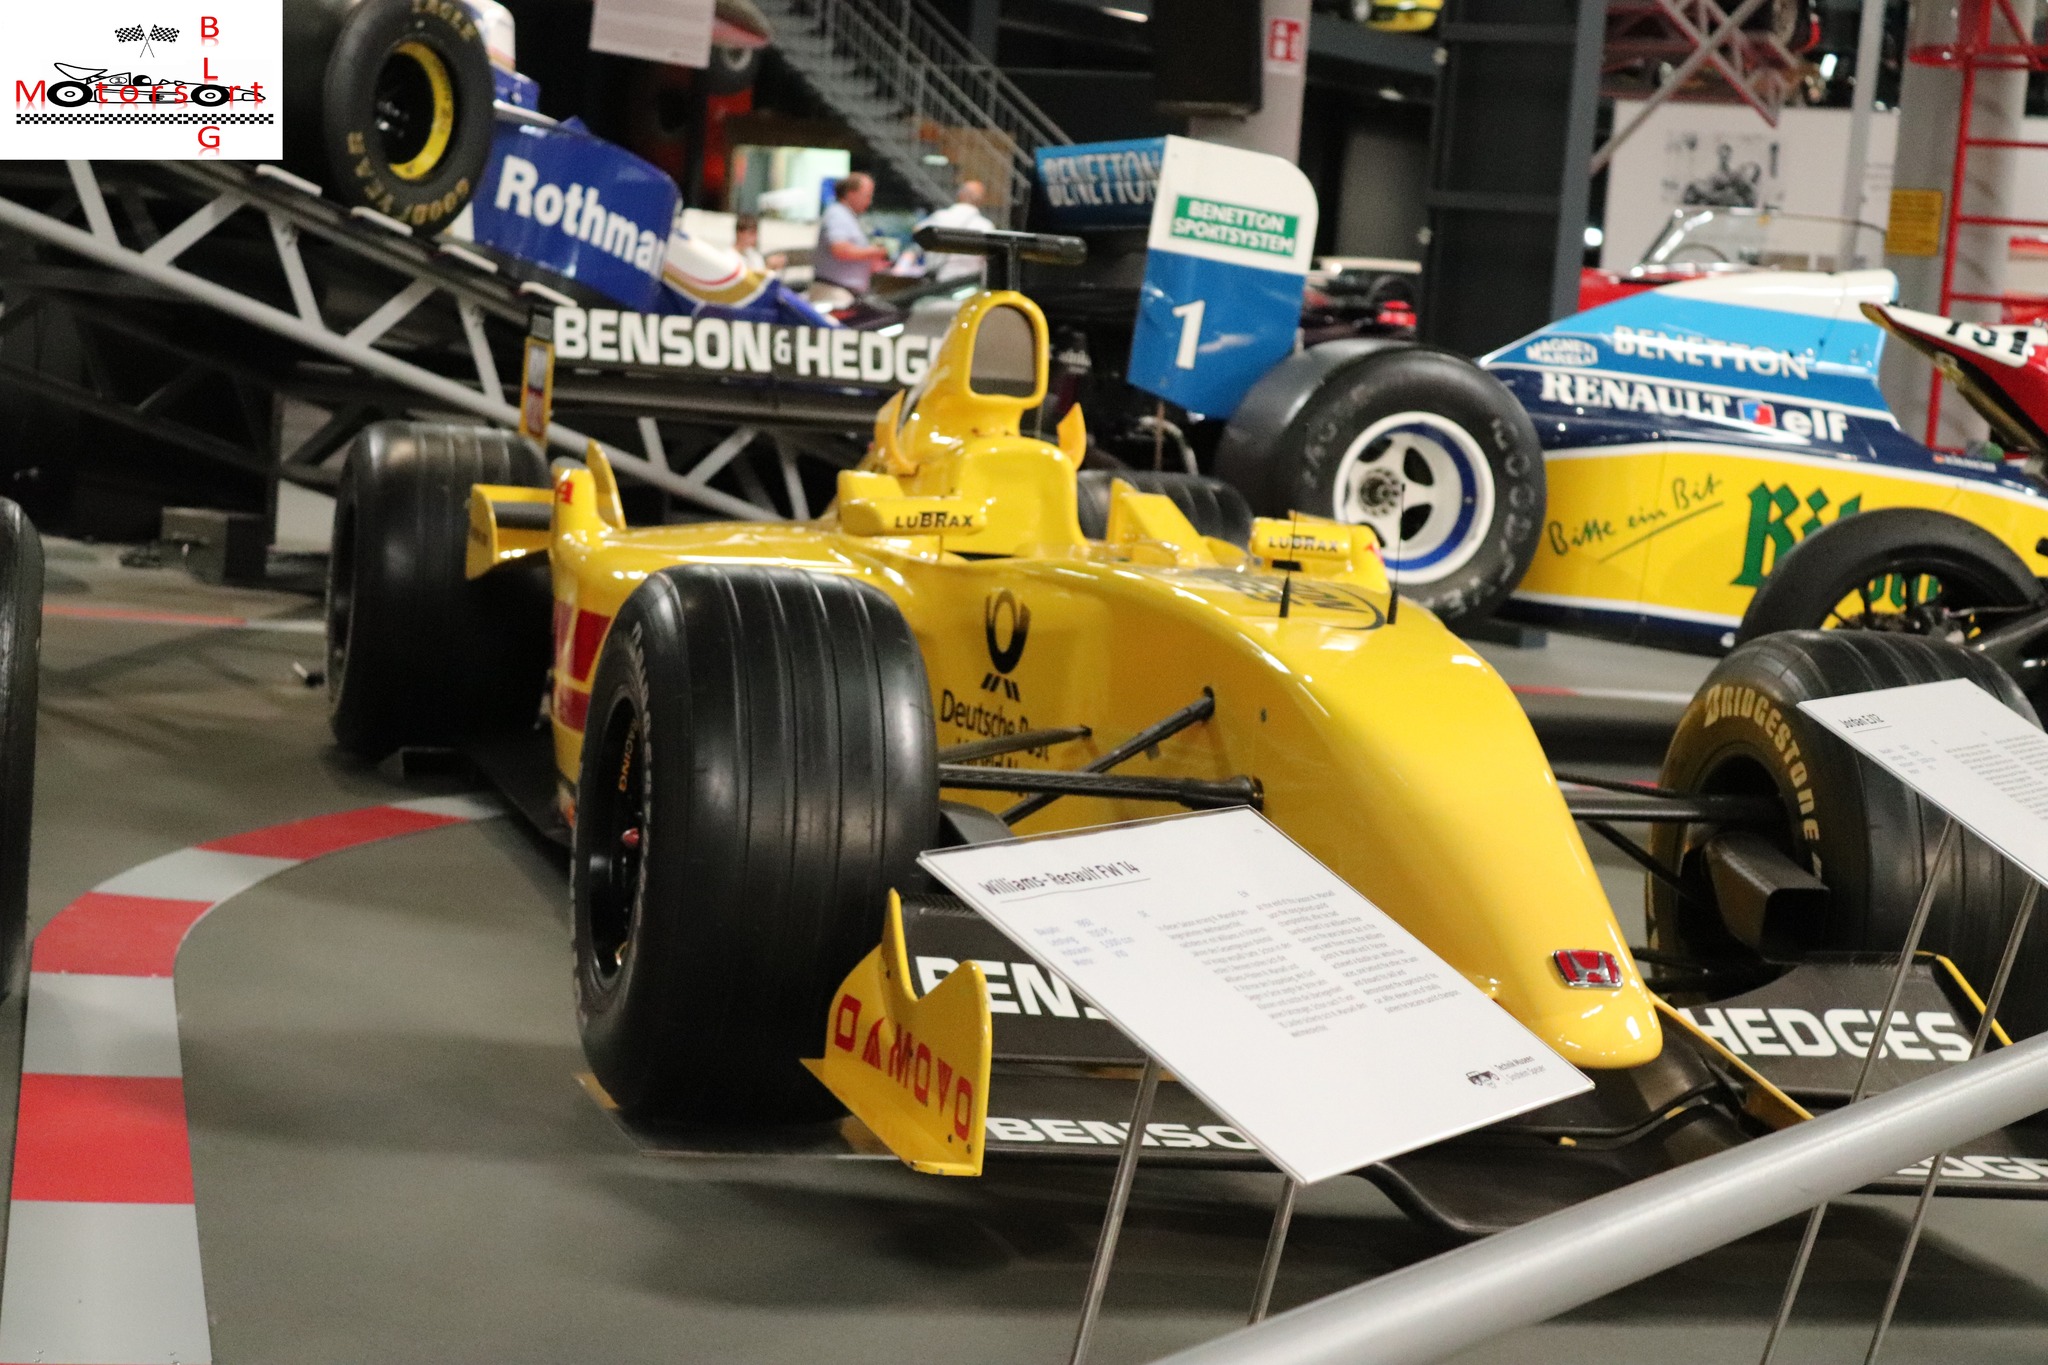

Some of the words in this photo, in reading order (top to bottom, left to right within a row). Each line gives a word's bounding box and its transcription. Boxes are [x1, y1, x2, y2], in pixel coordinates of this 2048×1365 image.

[1173, 216, 1296, 257] SPORTSYSTEM
[1188, 199, 1286, 234] BENETTON
[554, 306, 771, 373] BENSON
[1172, 300, 1206, 370] 1
[1613, 325, 1810, 380] BENETTON
[1539, 371, 1732, 419] RENAULT
[1781, 407, 1849, 443] elf
[894, 511, 973, 529] LUBRAX
[1627, 507, 1667, 530] ein
[1672, 473, 1724, 512] Bit
[1268, 534, 1338, 553] LUBRAX
[940, 688, 1016, 738] Deutsche
[1703, 684, 1820, 841] BRIDGESTONE
[1045, 866, 1103, 886] Renault
[1095, 863, 1124, 879] FW
[1678, 1007, 1972, 1062] HEDGES
[834, 993, 974, 1142] DAMOVO
